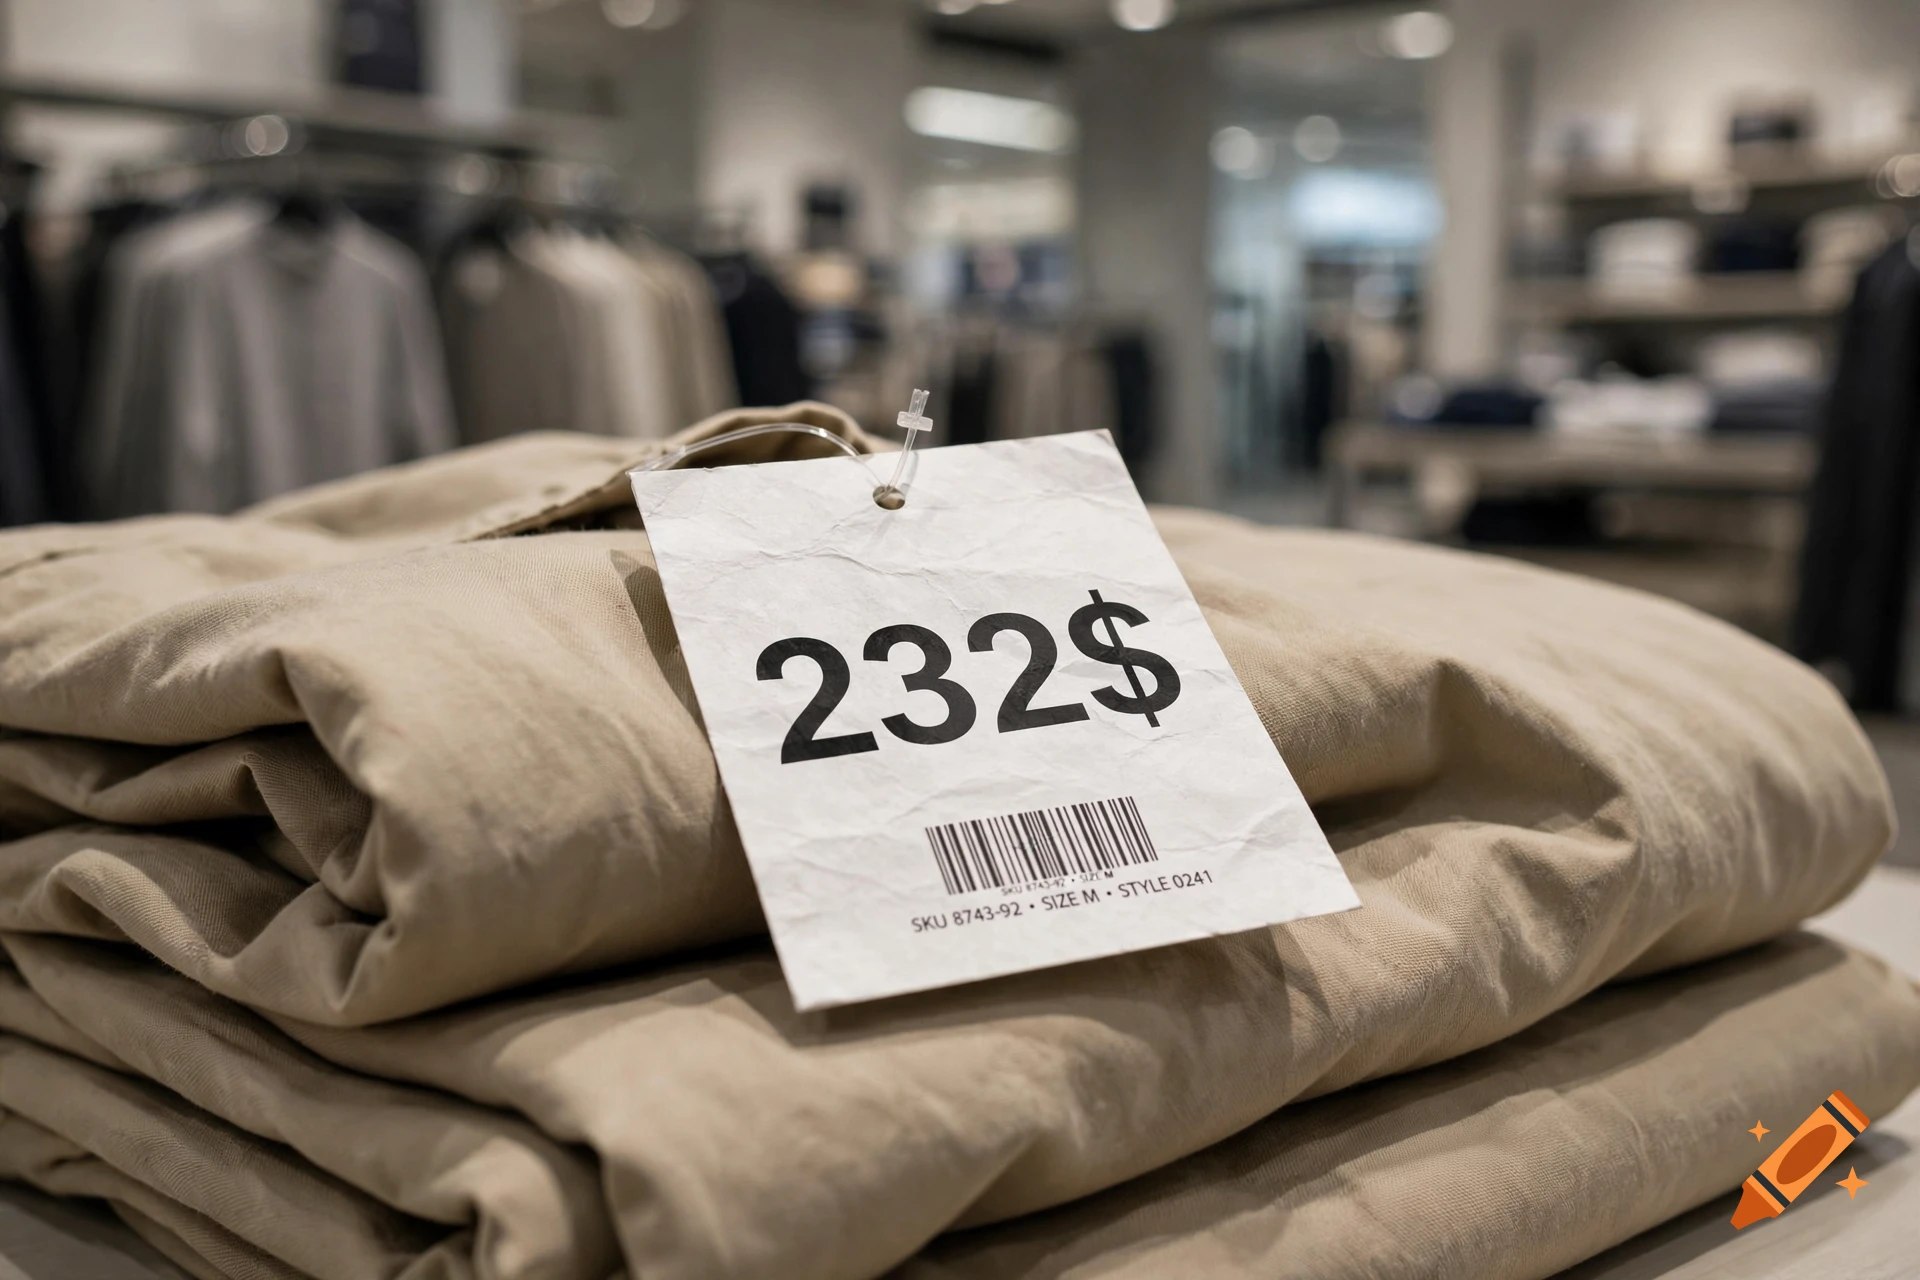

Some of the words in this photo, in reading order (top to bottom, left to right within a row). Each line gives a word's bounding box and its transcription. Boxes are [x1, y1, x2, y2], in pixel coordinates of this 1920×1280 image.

[755, 589, 1181, 765] 232$
[911, 914, 948, 932] SKU
[952, 901, 1022, 926] 8743-92
[1041, 891, 1080, 911] SIZE
[1081, 888, 1100, 904] M
[1118, 876, 1172, 898] STYLE
[1172, 869, 1214, 889] 0241
[1104, 870, 1114, 879] M
